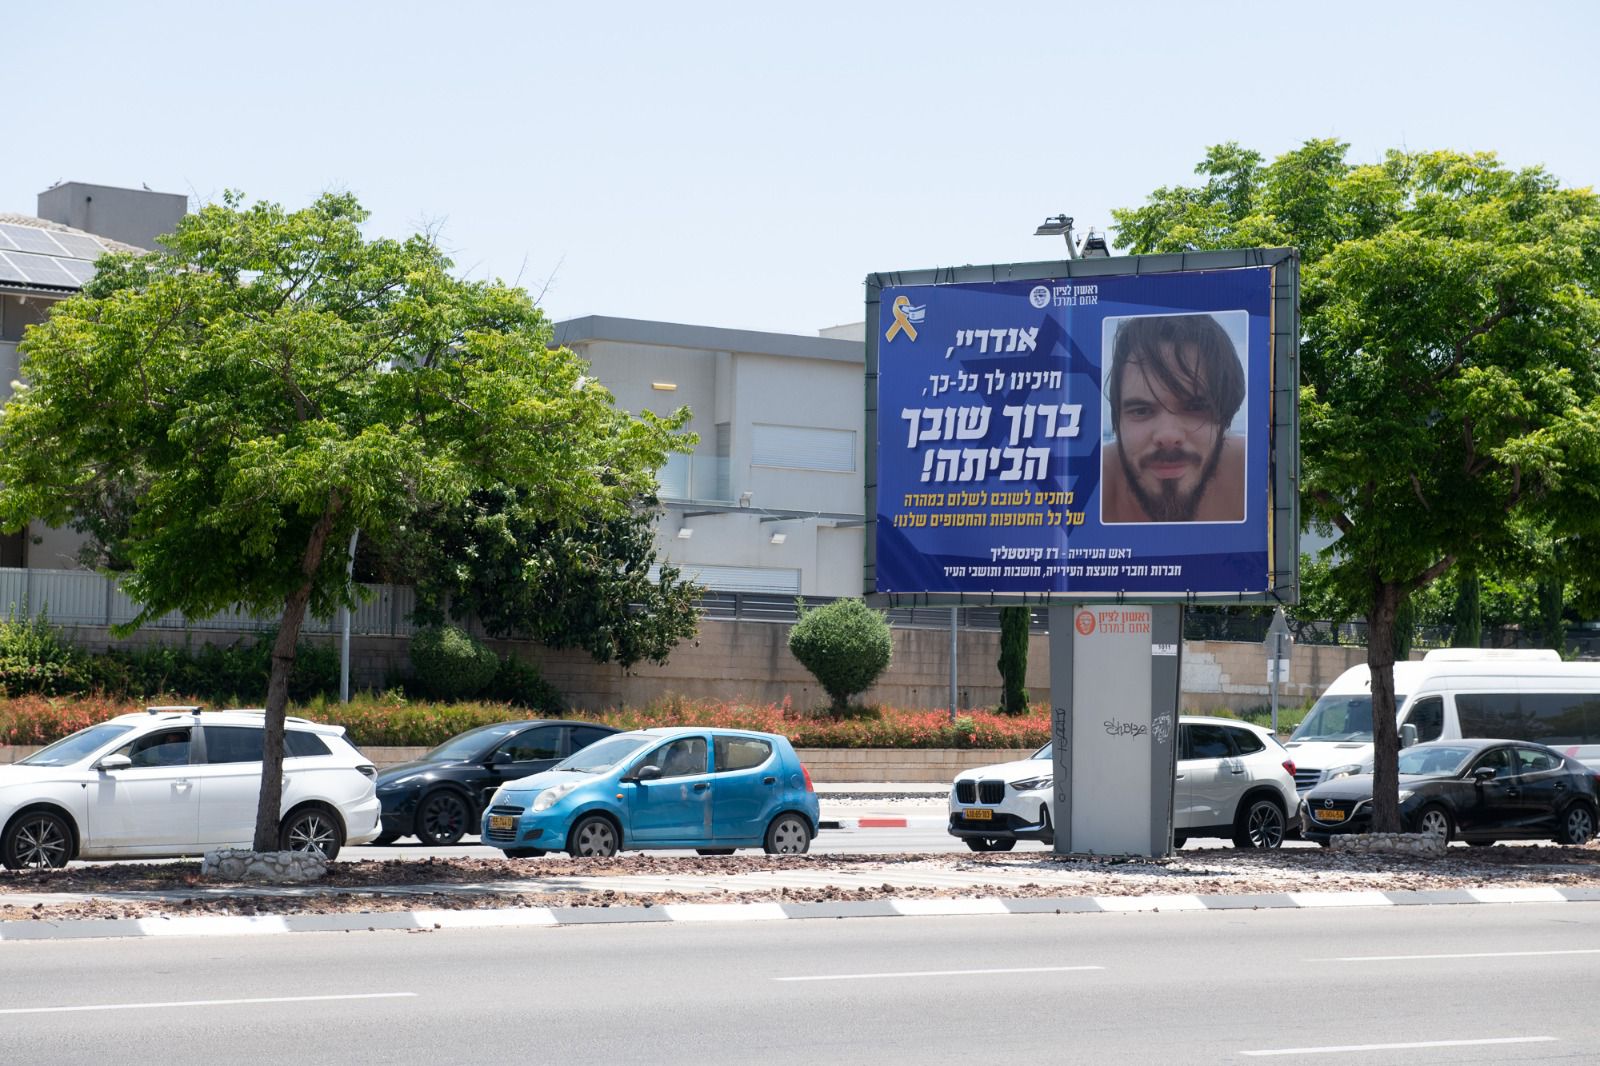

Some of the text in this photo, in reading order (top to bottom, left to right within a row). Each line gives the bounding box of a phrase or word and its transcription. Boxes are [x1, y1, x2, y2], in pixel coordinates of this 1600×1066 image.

[1053, 285, 1098, 298] ראשון לציון
[945, 327, 1039, 359] אנדריי,
[922, 369, 1062, 396] חיכינו לך כל-כך,
[901, 403, 1082, 448] ברוך שובך
[920, 446, 1050, 482] הביתה!
[904, 490, 1074, 507] מחכים לשובם לשלום במהרה
[893, 510, 1085, 528] של כל החטופות והחטופים שלנו!
[990, 546, 1044, 562] קינסטליך
[1046, 548, 1059, 560] רז
[1068, 548, 1106, 559] העירייה
[1108, 548, 1132, 558] ראש
[944, 566, 966, 576] העיר
[968, 566, 1002, 576] ותושבי
[1004, 566, 1041, 576] תושבות
[1086, 566, 1118, 576] מועצת
[1122, 566, 1148, 576] וחברי
[1150, 566, 1182, 576] חברות
[1098, 610, 1150, 624] ראשון לציון
